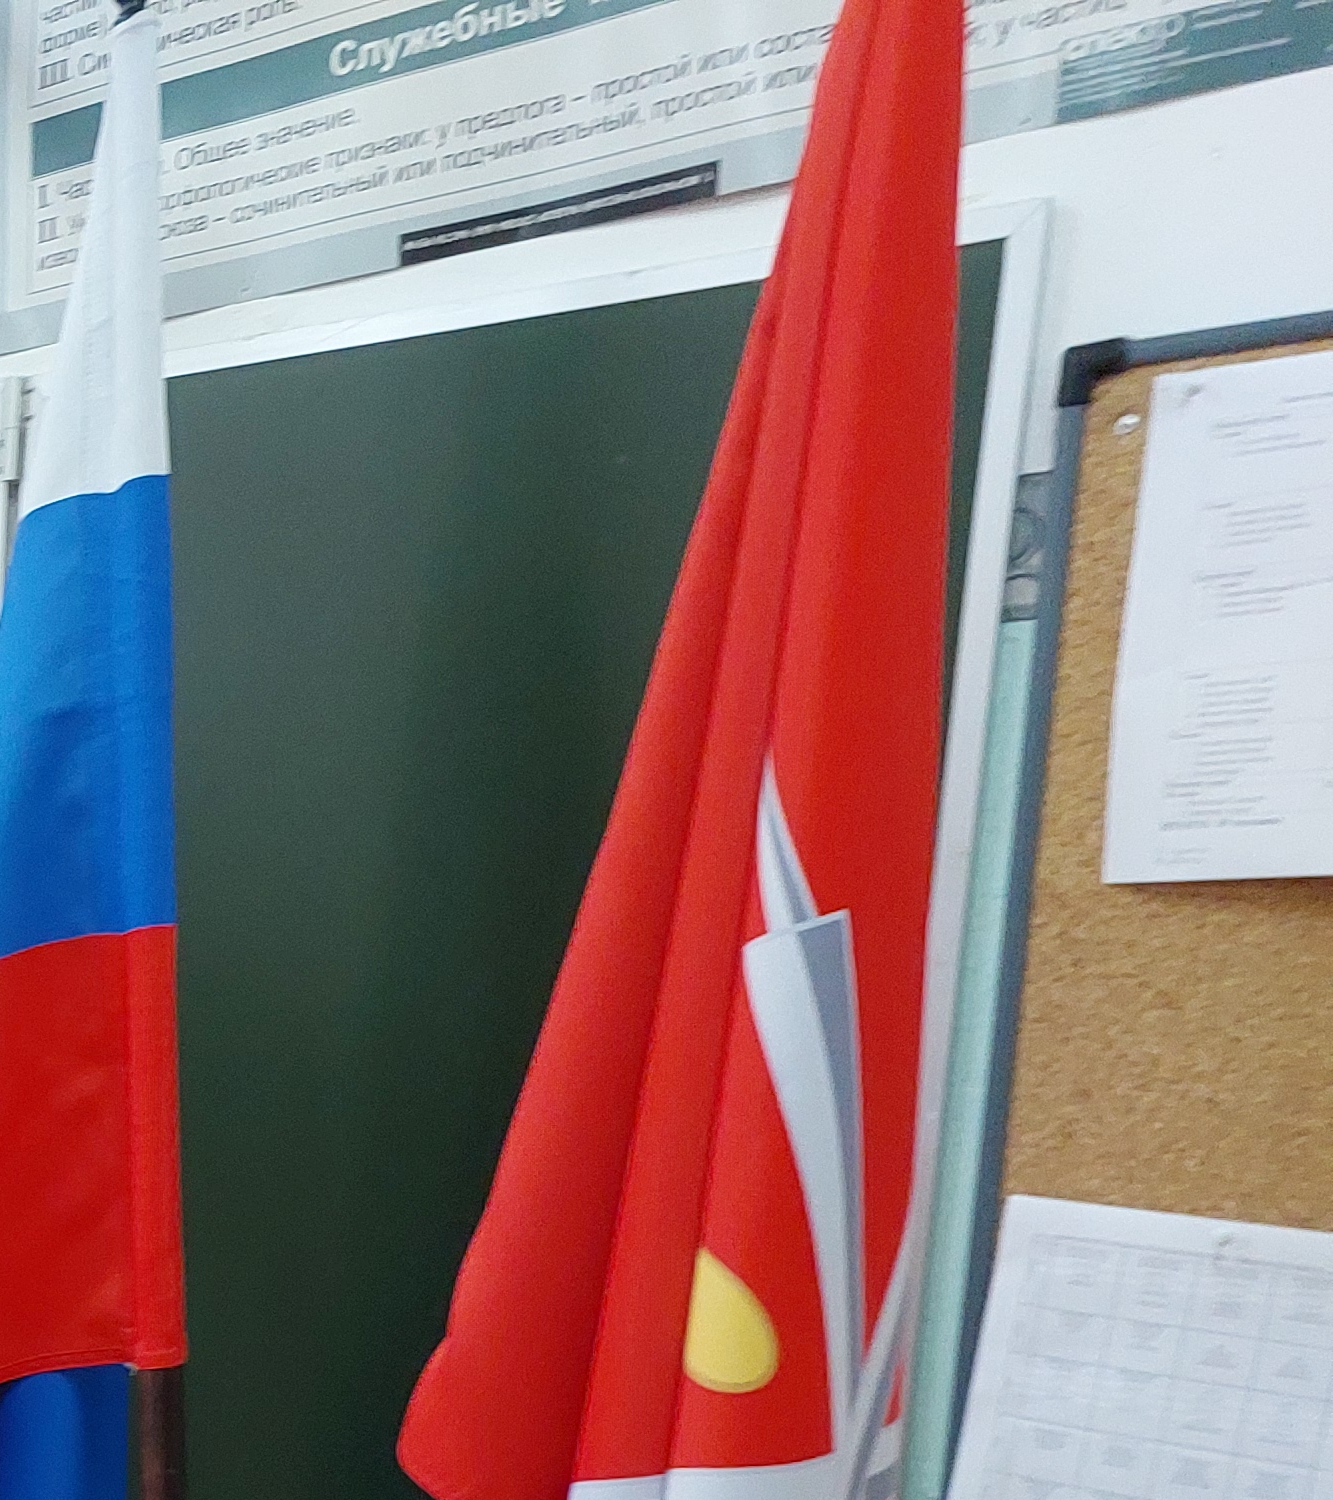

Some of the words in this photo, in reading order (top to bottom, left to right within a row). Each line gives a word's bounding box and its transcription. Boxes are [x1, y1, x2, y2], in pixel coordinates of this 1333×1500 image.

[329, 0, 569, 76] Служебные
[590, 52, 693, 105] простой
[754, 22, 834, 59] соста
[649, 69, 758, 124] простой
